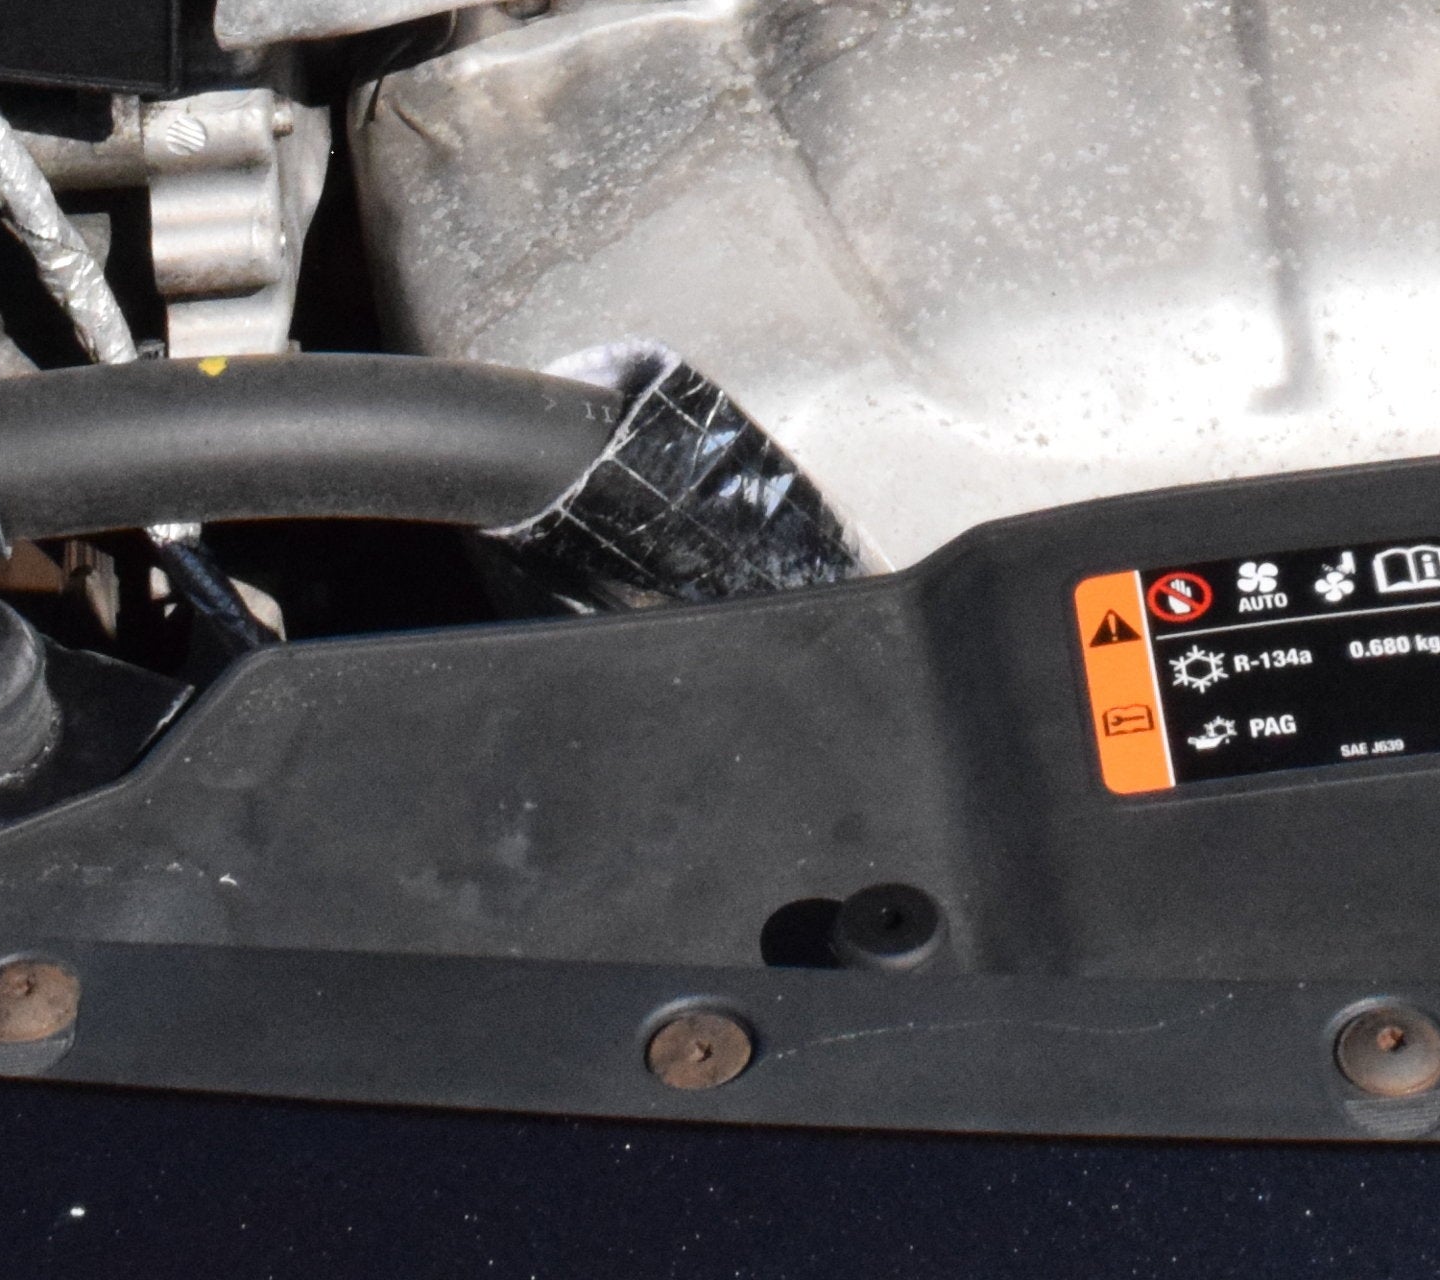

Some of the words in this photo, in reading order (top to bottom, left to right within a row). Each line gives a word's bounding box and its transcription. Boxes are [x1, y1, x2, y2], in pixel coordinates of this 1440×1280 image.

[1238, 591, 1288, 613] AUTO
[1234, 648, 1313, 673] R-134a
[1349, 636, 1410, 660] 0.680
[1250, 715, 1297, 738] PAG
[1340, 742, 1368, 758] SAE
[1371, 739, 1404, 755] J639
